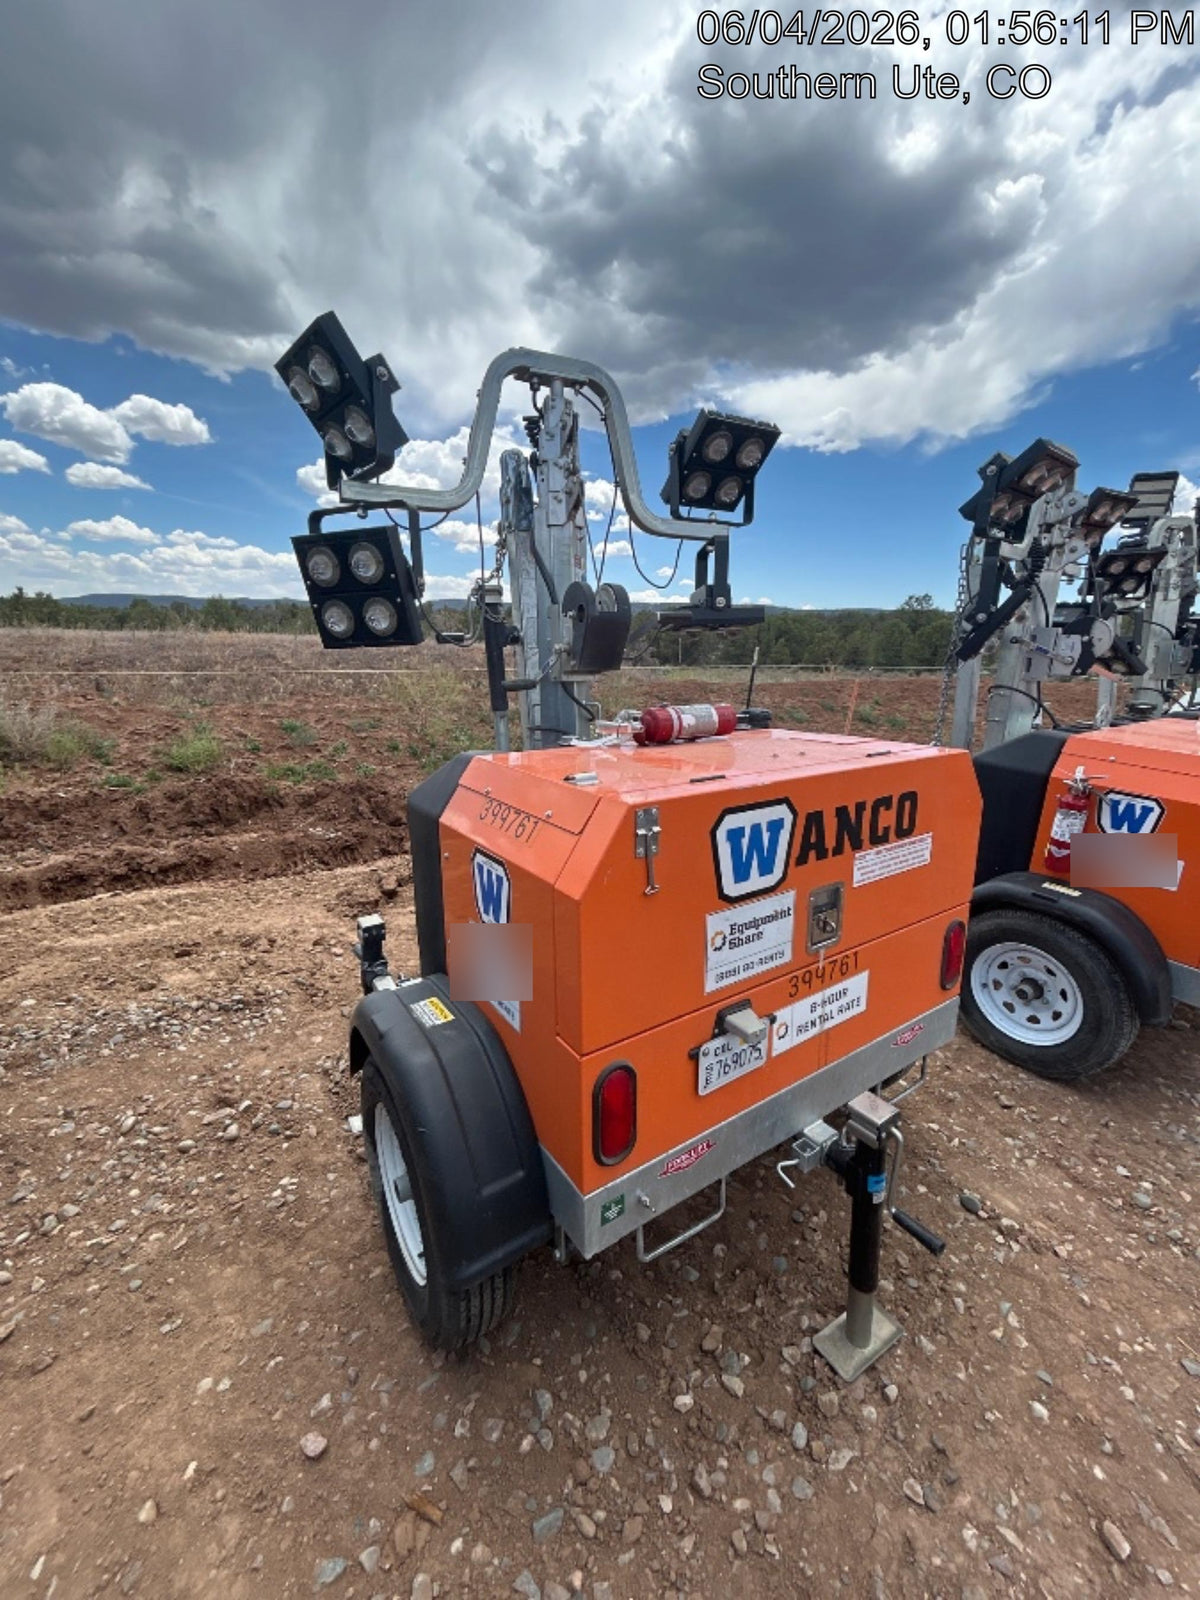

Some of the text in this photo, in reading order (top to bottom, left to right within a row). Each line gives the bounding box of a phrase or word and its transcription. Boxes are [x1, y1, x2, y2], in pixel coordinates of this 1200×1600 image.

[479, 798, 540, 843] 399761
[728, 905, 793, 937] Equipment
[728, 931, 764, 950] Share
[788, 951, 859, 998] 399761
[795, 995, 862, 1037] RENTAL RATE
[809, 987, 849, 1014] 8-HOUR
